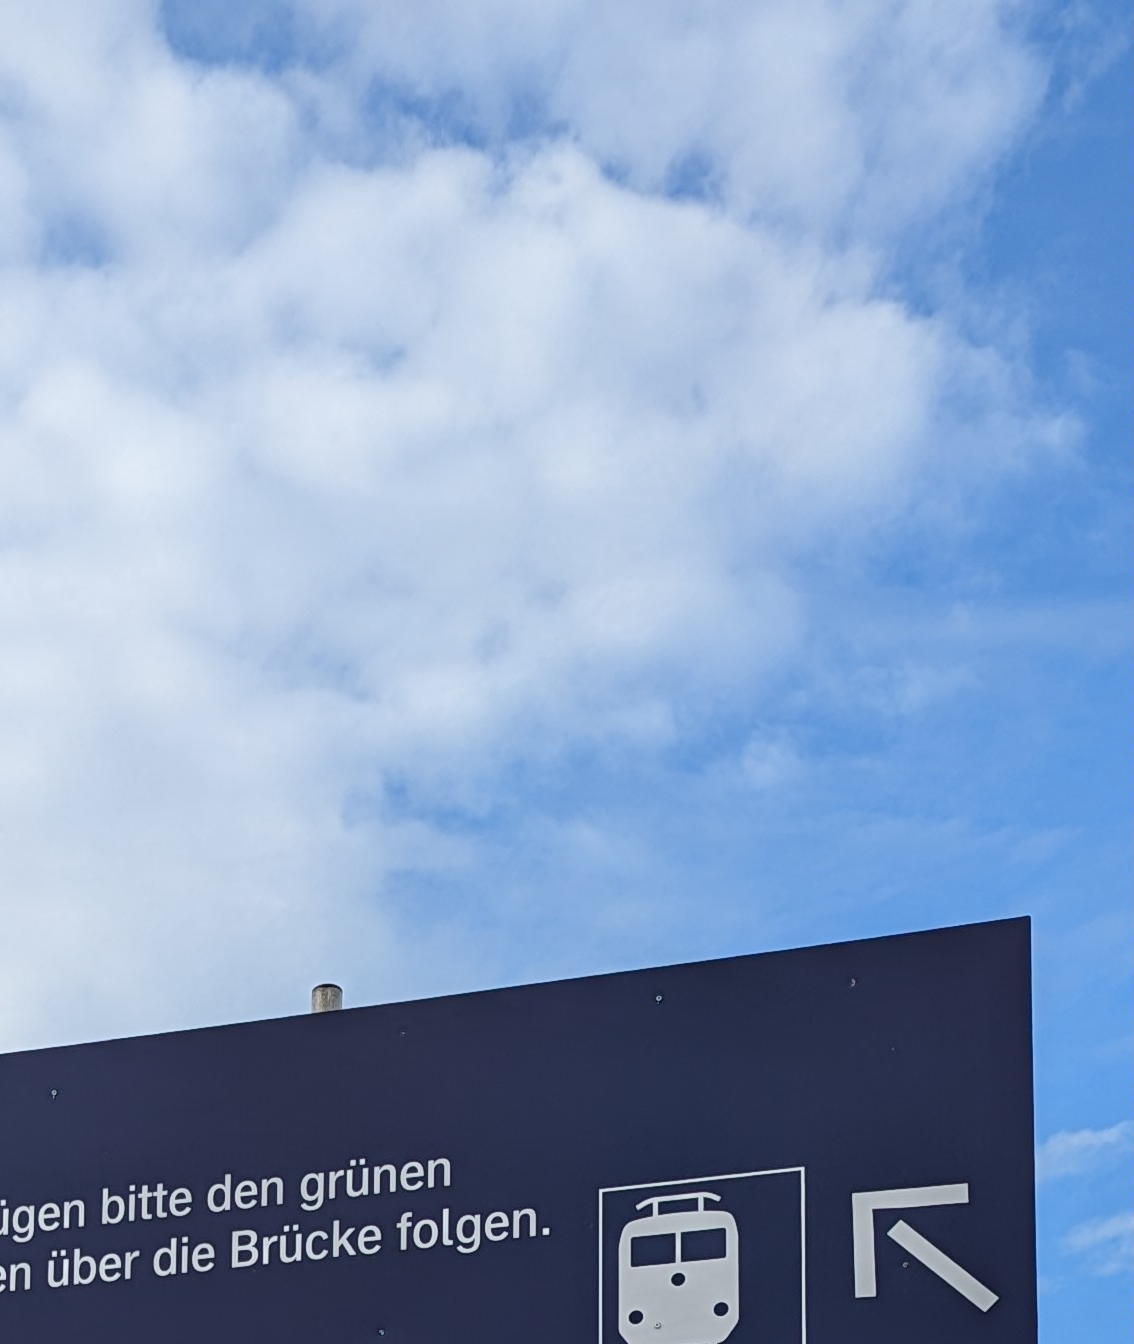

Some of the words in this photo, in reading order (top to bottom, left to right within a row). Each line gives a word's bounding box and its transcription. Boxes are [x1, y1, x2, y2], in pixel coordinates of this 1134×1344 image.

[101, 1182, 193, 1225] bitte
[207, 1173, 284, 1214] den
[299, 1157, 452, 1212] grünen
[47, 1249, 140, 1288] über
[153, 1236, 215, 1277] die
[231, 1223, 382, 1269] Brücke
[397, 1208, 550, 1258] folgen.
